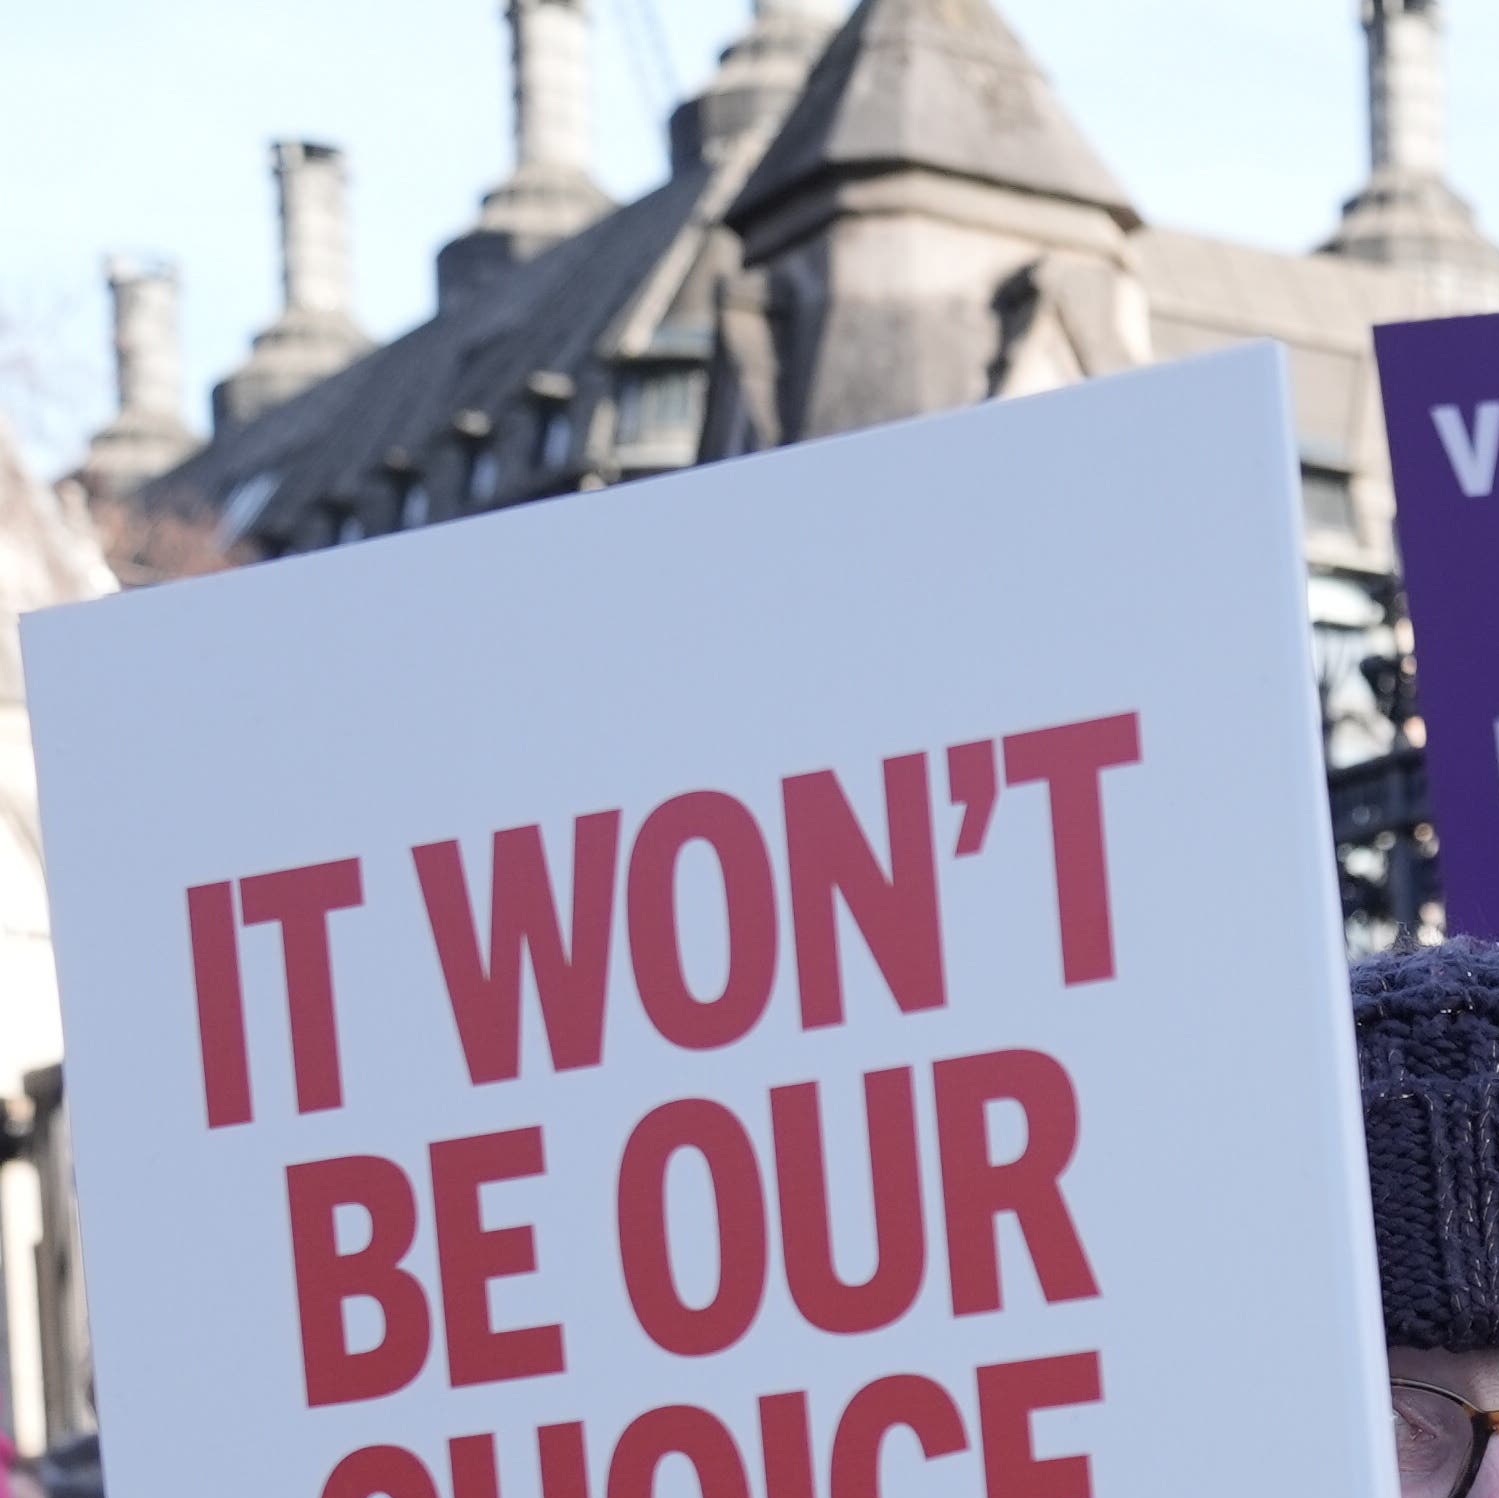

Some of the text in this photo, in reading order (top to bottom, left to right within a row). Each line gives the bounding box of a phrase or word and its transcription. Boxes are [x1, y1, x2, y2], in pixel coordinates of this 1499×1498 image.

[187, 712, 1141, 1128] IT WON'T
[286, 1048, 1101, 1407] BE OUR
